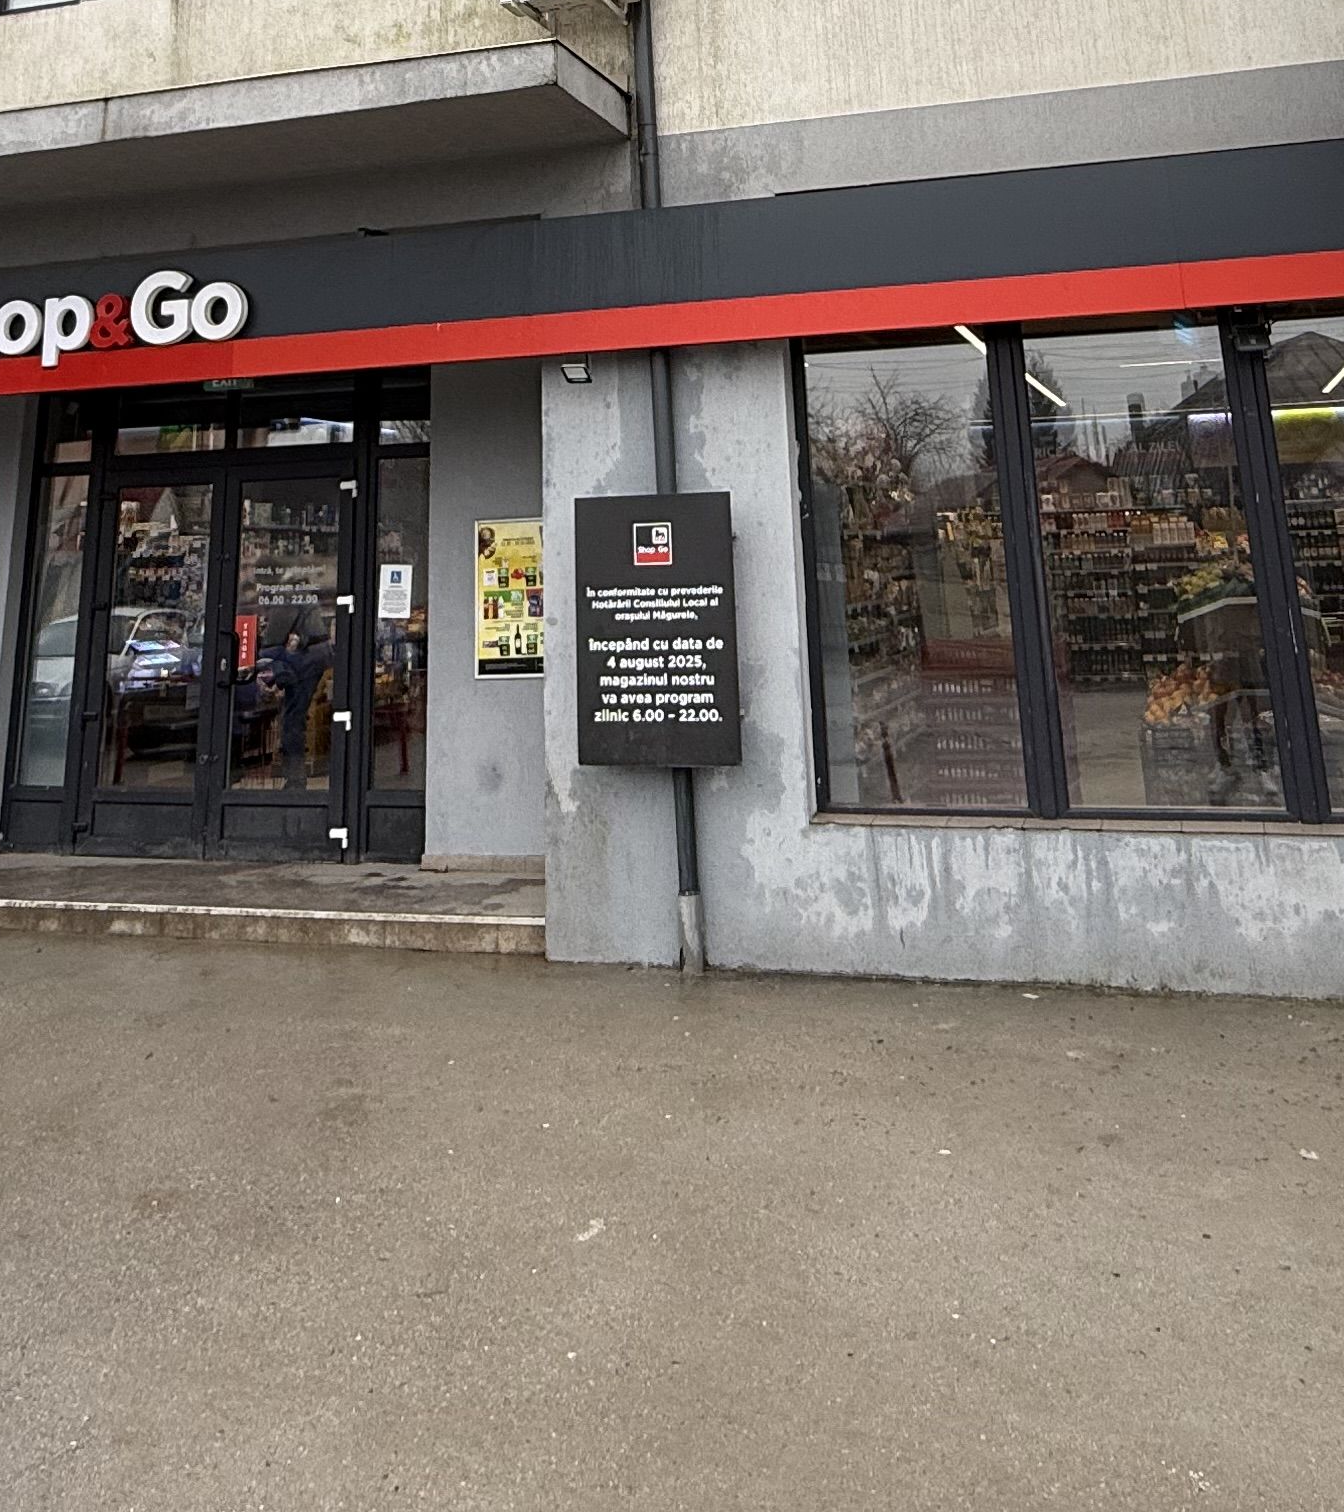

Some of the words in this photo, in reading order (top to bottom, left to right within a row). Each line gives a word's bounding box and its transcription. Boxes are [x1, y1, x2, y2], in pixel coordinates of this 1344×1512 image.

[657, 588, 669, 596] cu
[682, 596, 708, 607] Local
[709, 596, 719, 607] al
[652, 639, 669, 650] cu
[672, 637, 703, 650] data
[705, 637, 725, 650] de
[606, 656, 617, 669] 4
[619, 656, 665, 670] august
[667, 654, 707, 670] 2025,
[599, 672, 668, 688] magazinul
[671, 673, 715, 686] nostru
[601, 693, 618, 704] va
[620, 693, 653, 704] avea
[655, 692, 714, 706] program
[593, 708, 629, 722] zilnic
[632, 708, 665, 722] 6.00
[678, 708, 724, 722] 22.00.
